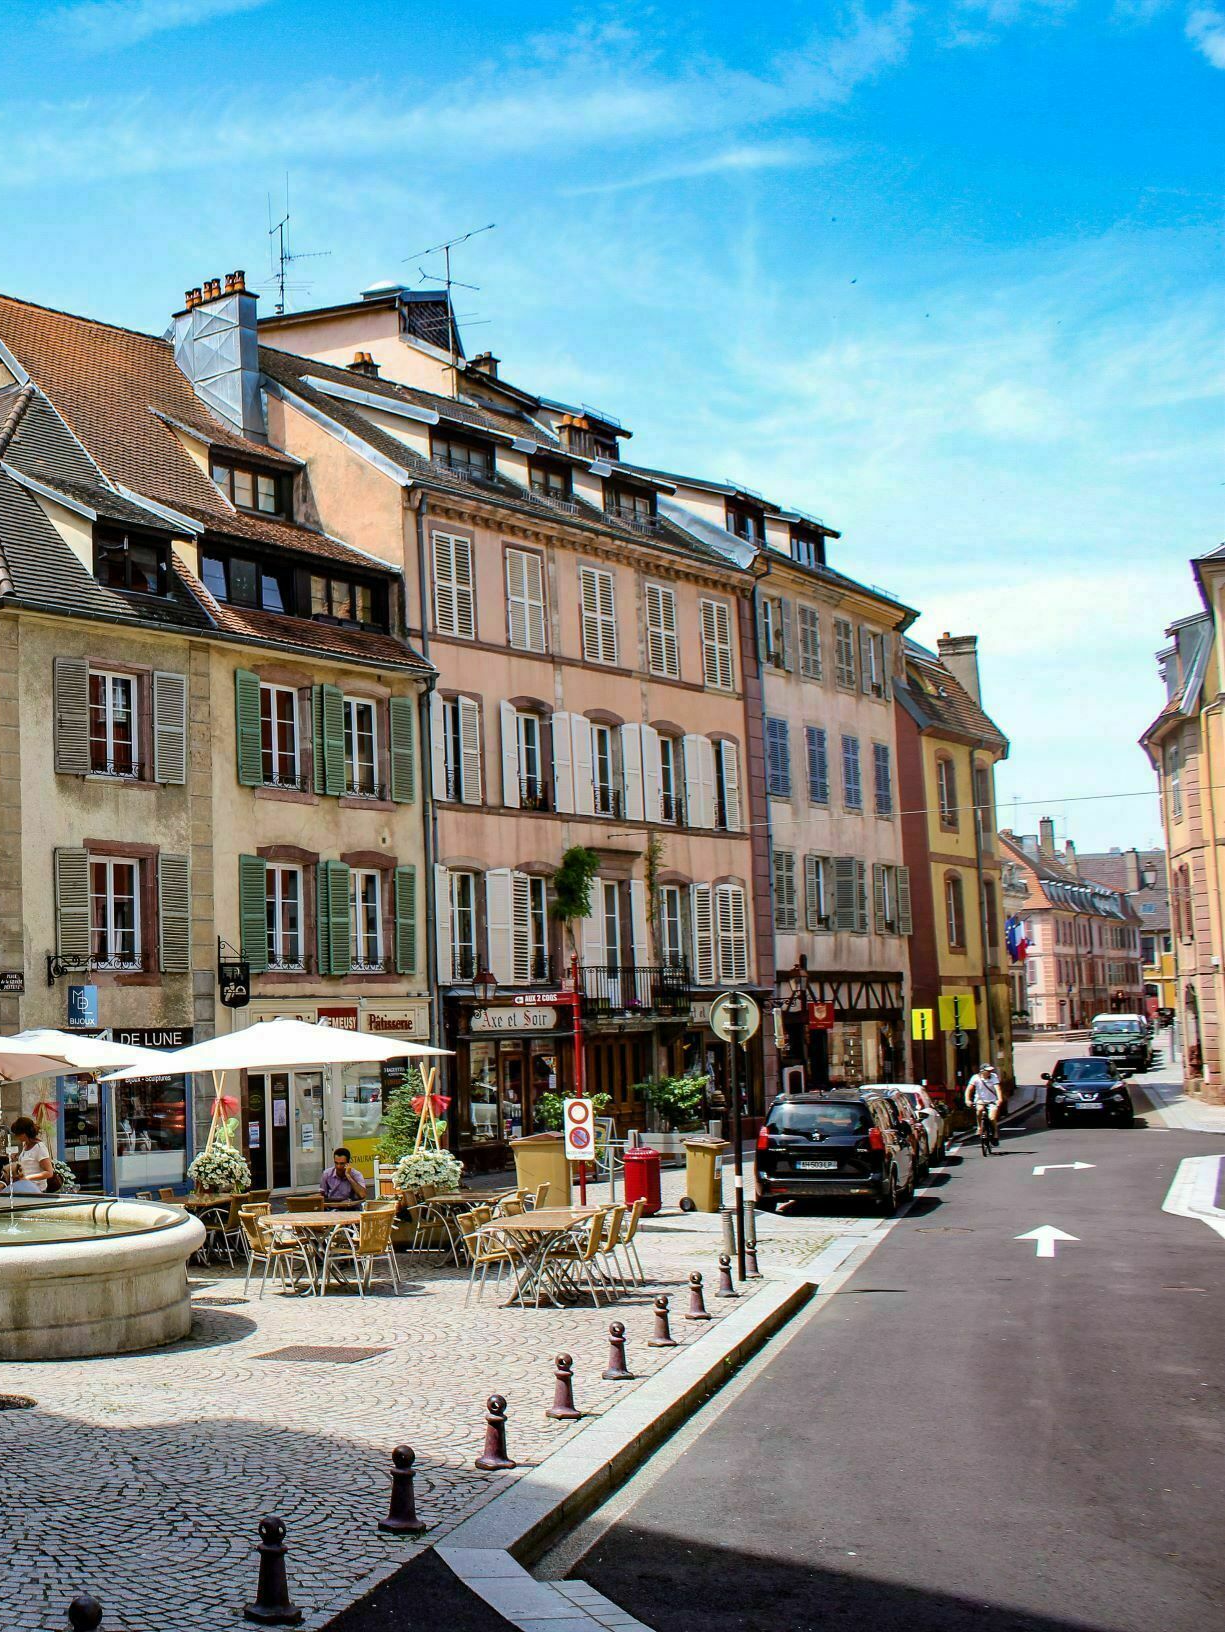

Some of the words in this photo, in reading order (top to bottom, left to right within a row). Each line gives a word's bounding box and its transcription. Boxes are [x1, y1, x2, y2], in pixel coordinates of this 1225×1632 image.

[525, 994, 536, 1002] AUX
[537, 994, 541, 1002] 2
[69, 1017, 95, 1025] BIJOUX
[328, 1016, 357, 1030] EMEUSY
[368, 1013, 414, 1031] Pâtisserie
[482, 1009, 504, 1028] Axe
[508, 1012, 517, 1028] et
[524, 1009, 548, 1027] Soir
[120, 1032, 141, 1045] DE
[144, 1031, 183, 1045] LUNE
